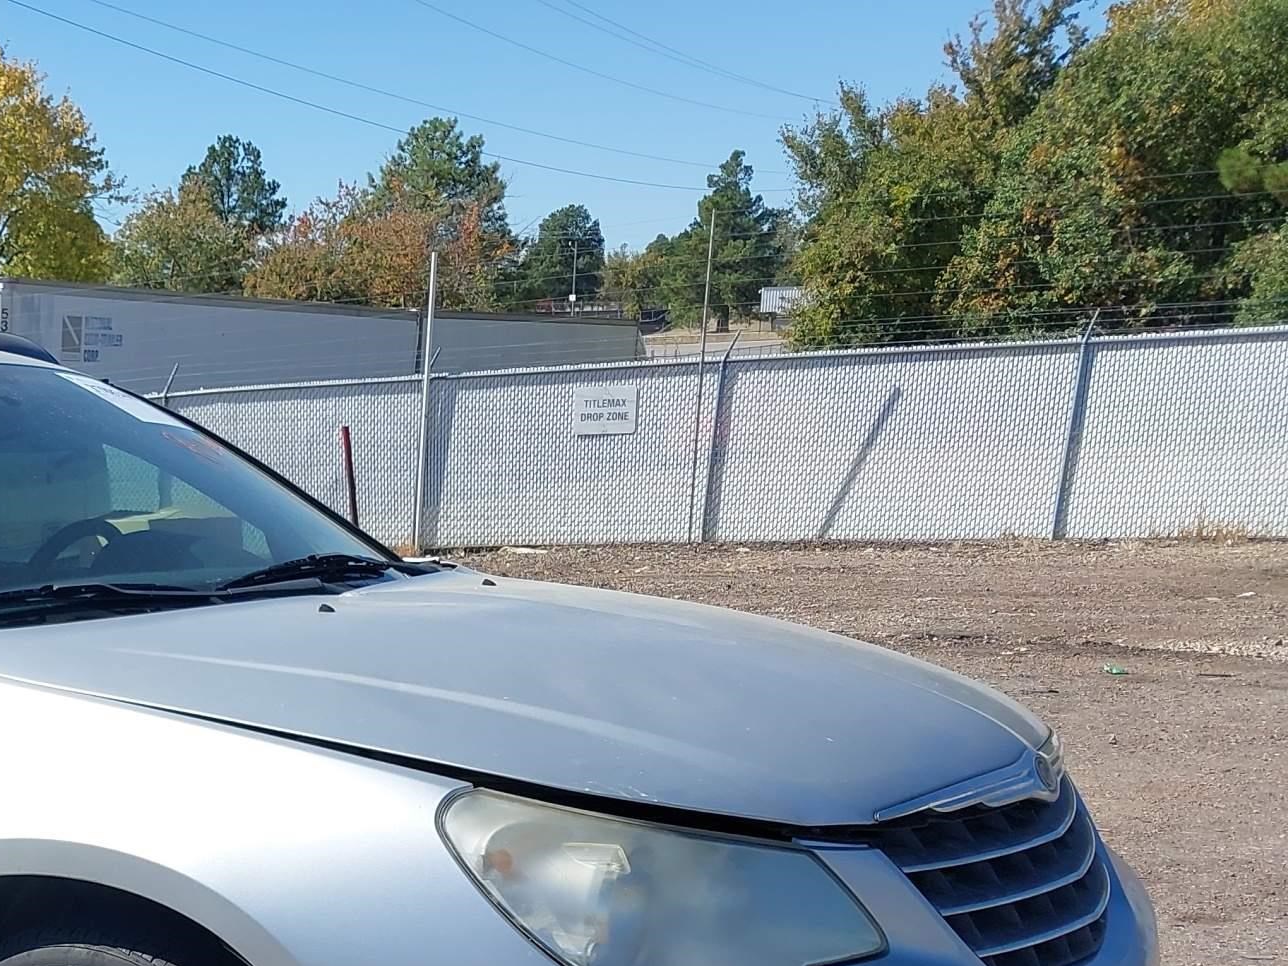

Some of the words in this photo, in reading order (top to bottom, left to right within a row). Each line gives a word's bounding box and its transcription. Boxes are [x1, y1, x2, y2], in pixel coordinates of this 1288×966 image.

[584, 399, 627, 409] TITLEMAX
[580, 412, 604, 422] DROP
[606, 411, 630, 421] ZONE
